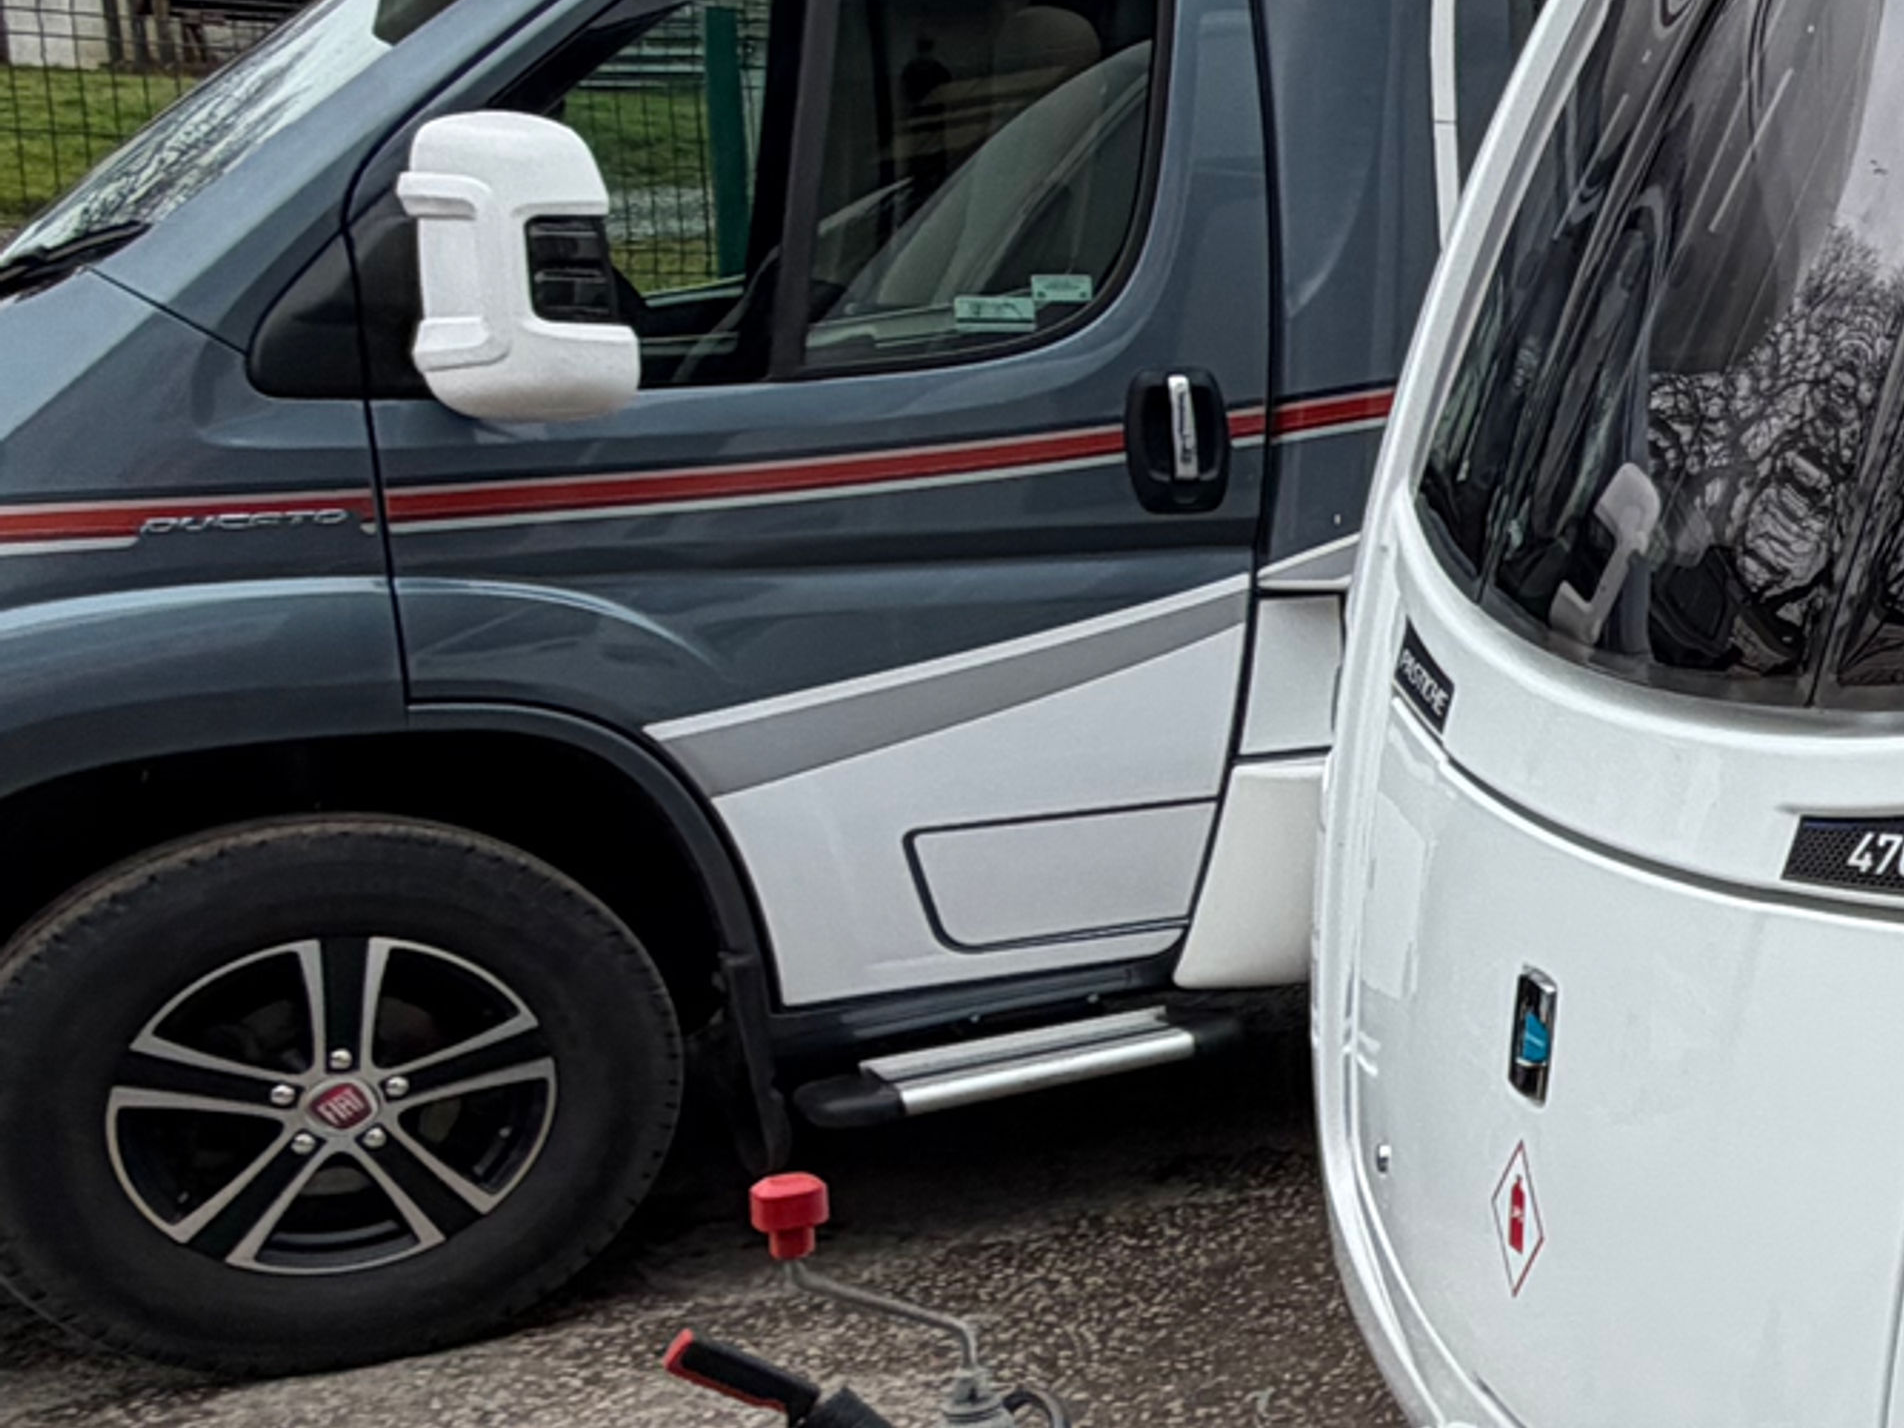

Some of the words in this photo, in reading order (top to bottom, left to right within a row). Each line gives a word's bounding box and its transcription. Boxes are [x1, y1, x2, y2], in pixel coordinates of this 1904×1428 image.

[139, 508, 348, 534] DUCATO
[1402, 649, 1449, 716] PASTICHE
[316, 1087, 365, 1125] FIAT
